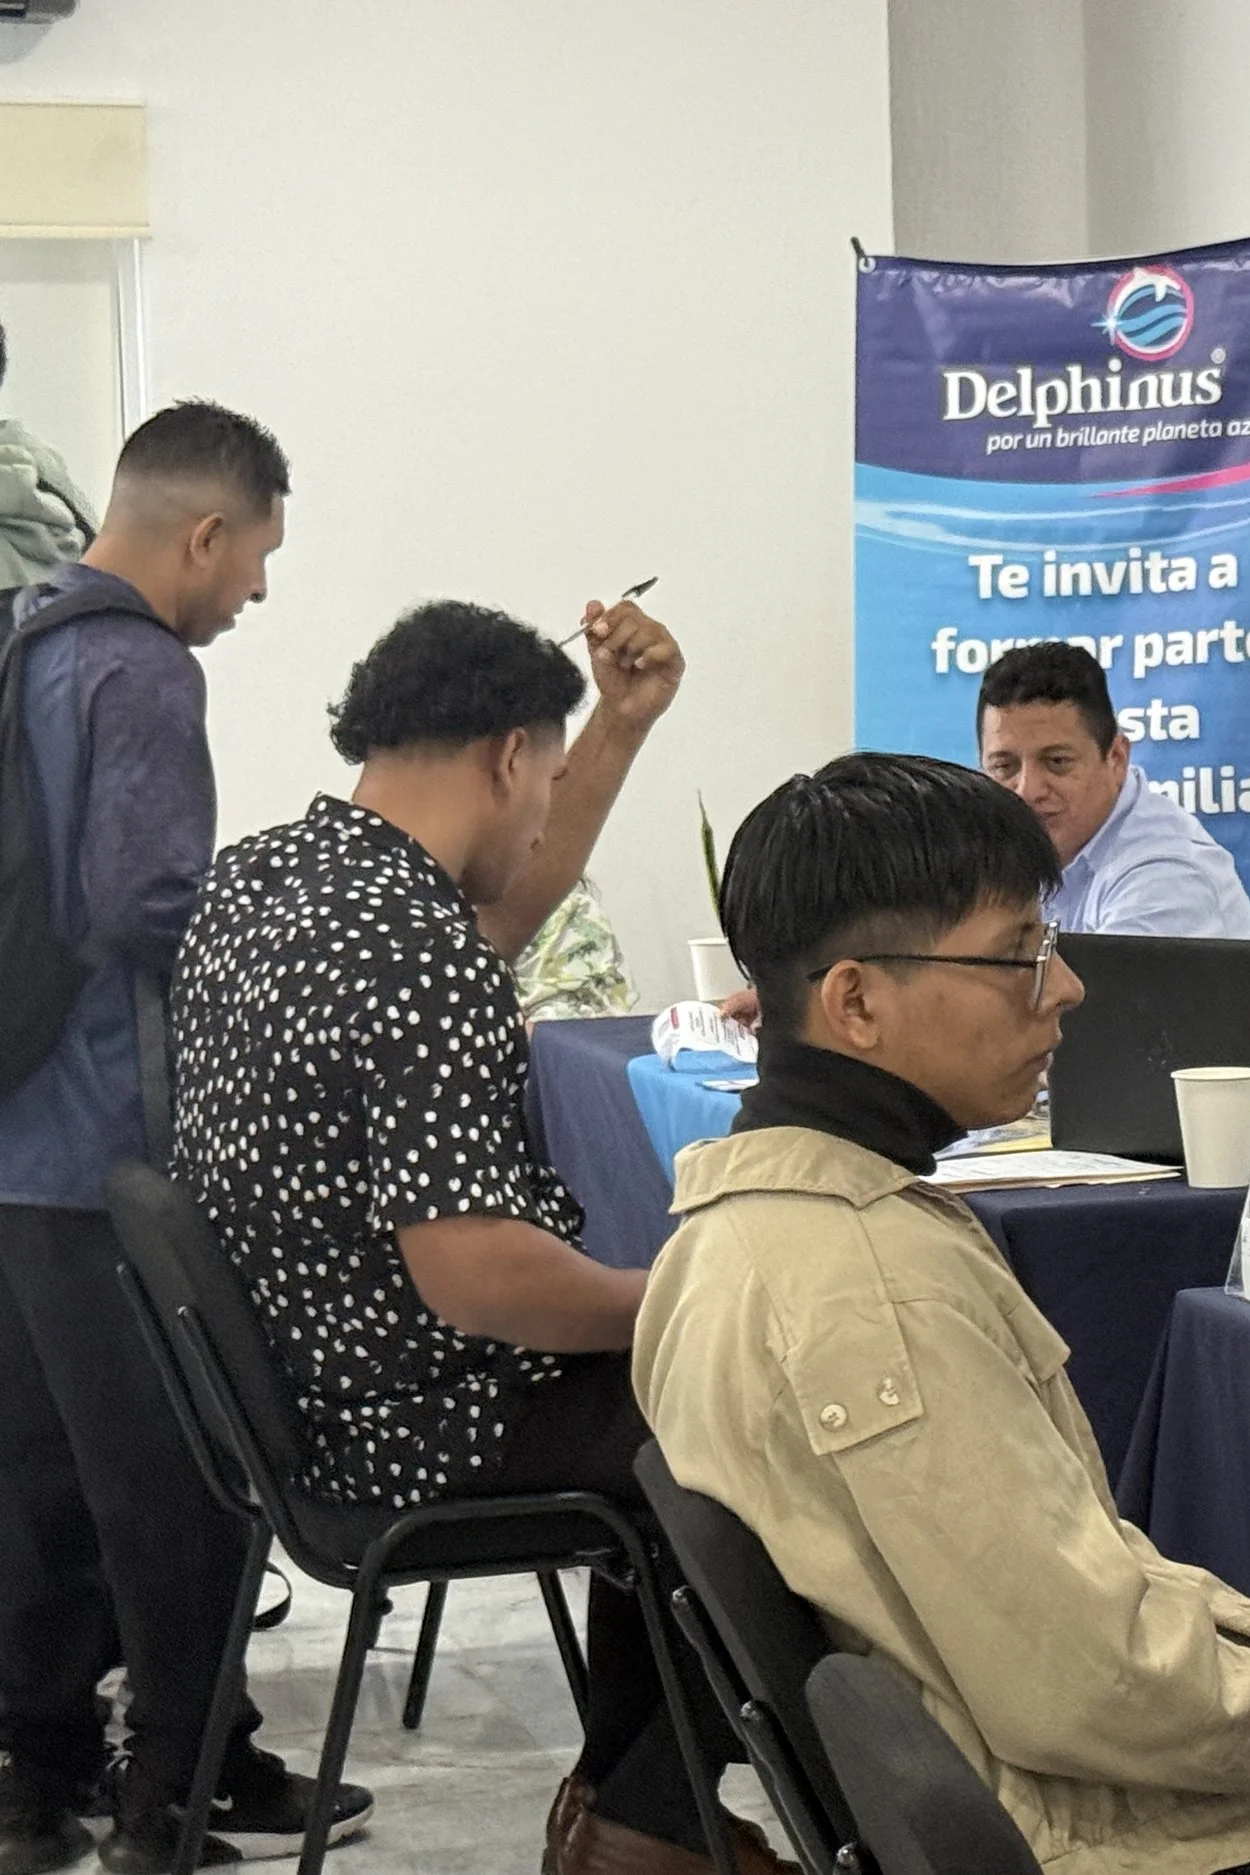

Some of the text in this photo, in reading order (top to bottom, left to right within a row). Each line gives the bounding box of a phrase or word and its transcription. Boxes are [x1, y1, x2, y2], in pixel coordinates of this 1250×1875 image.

[987, 431, 1023, 455] por
[1026, 429, 1051, 449] un
[1057, 424, 1139, 448] brillante
[1143, 419, 1221, 446] planeta
[968, 547, 1238, 600] Te invita a
[931, 627, 1124, 674] forr
[1117, 698, 1200, 742] sta
